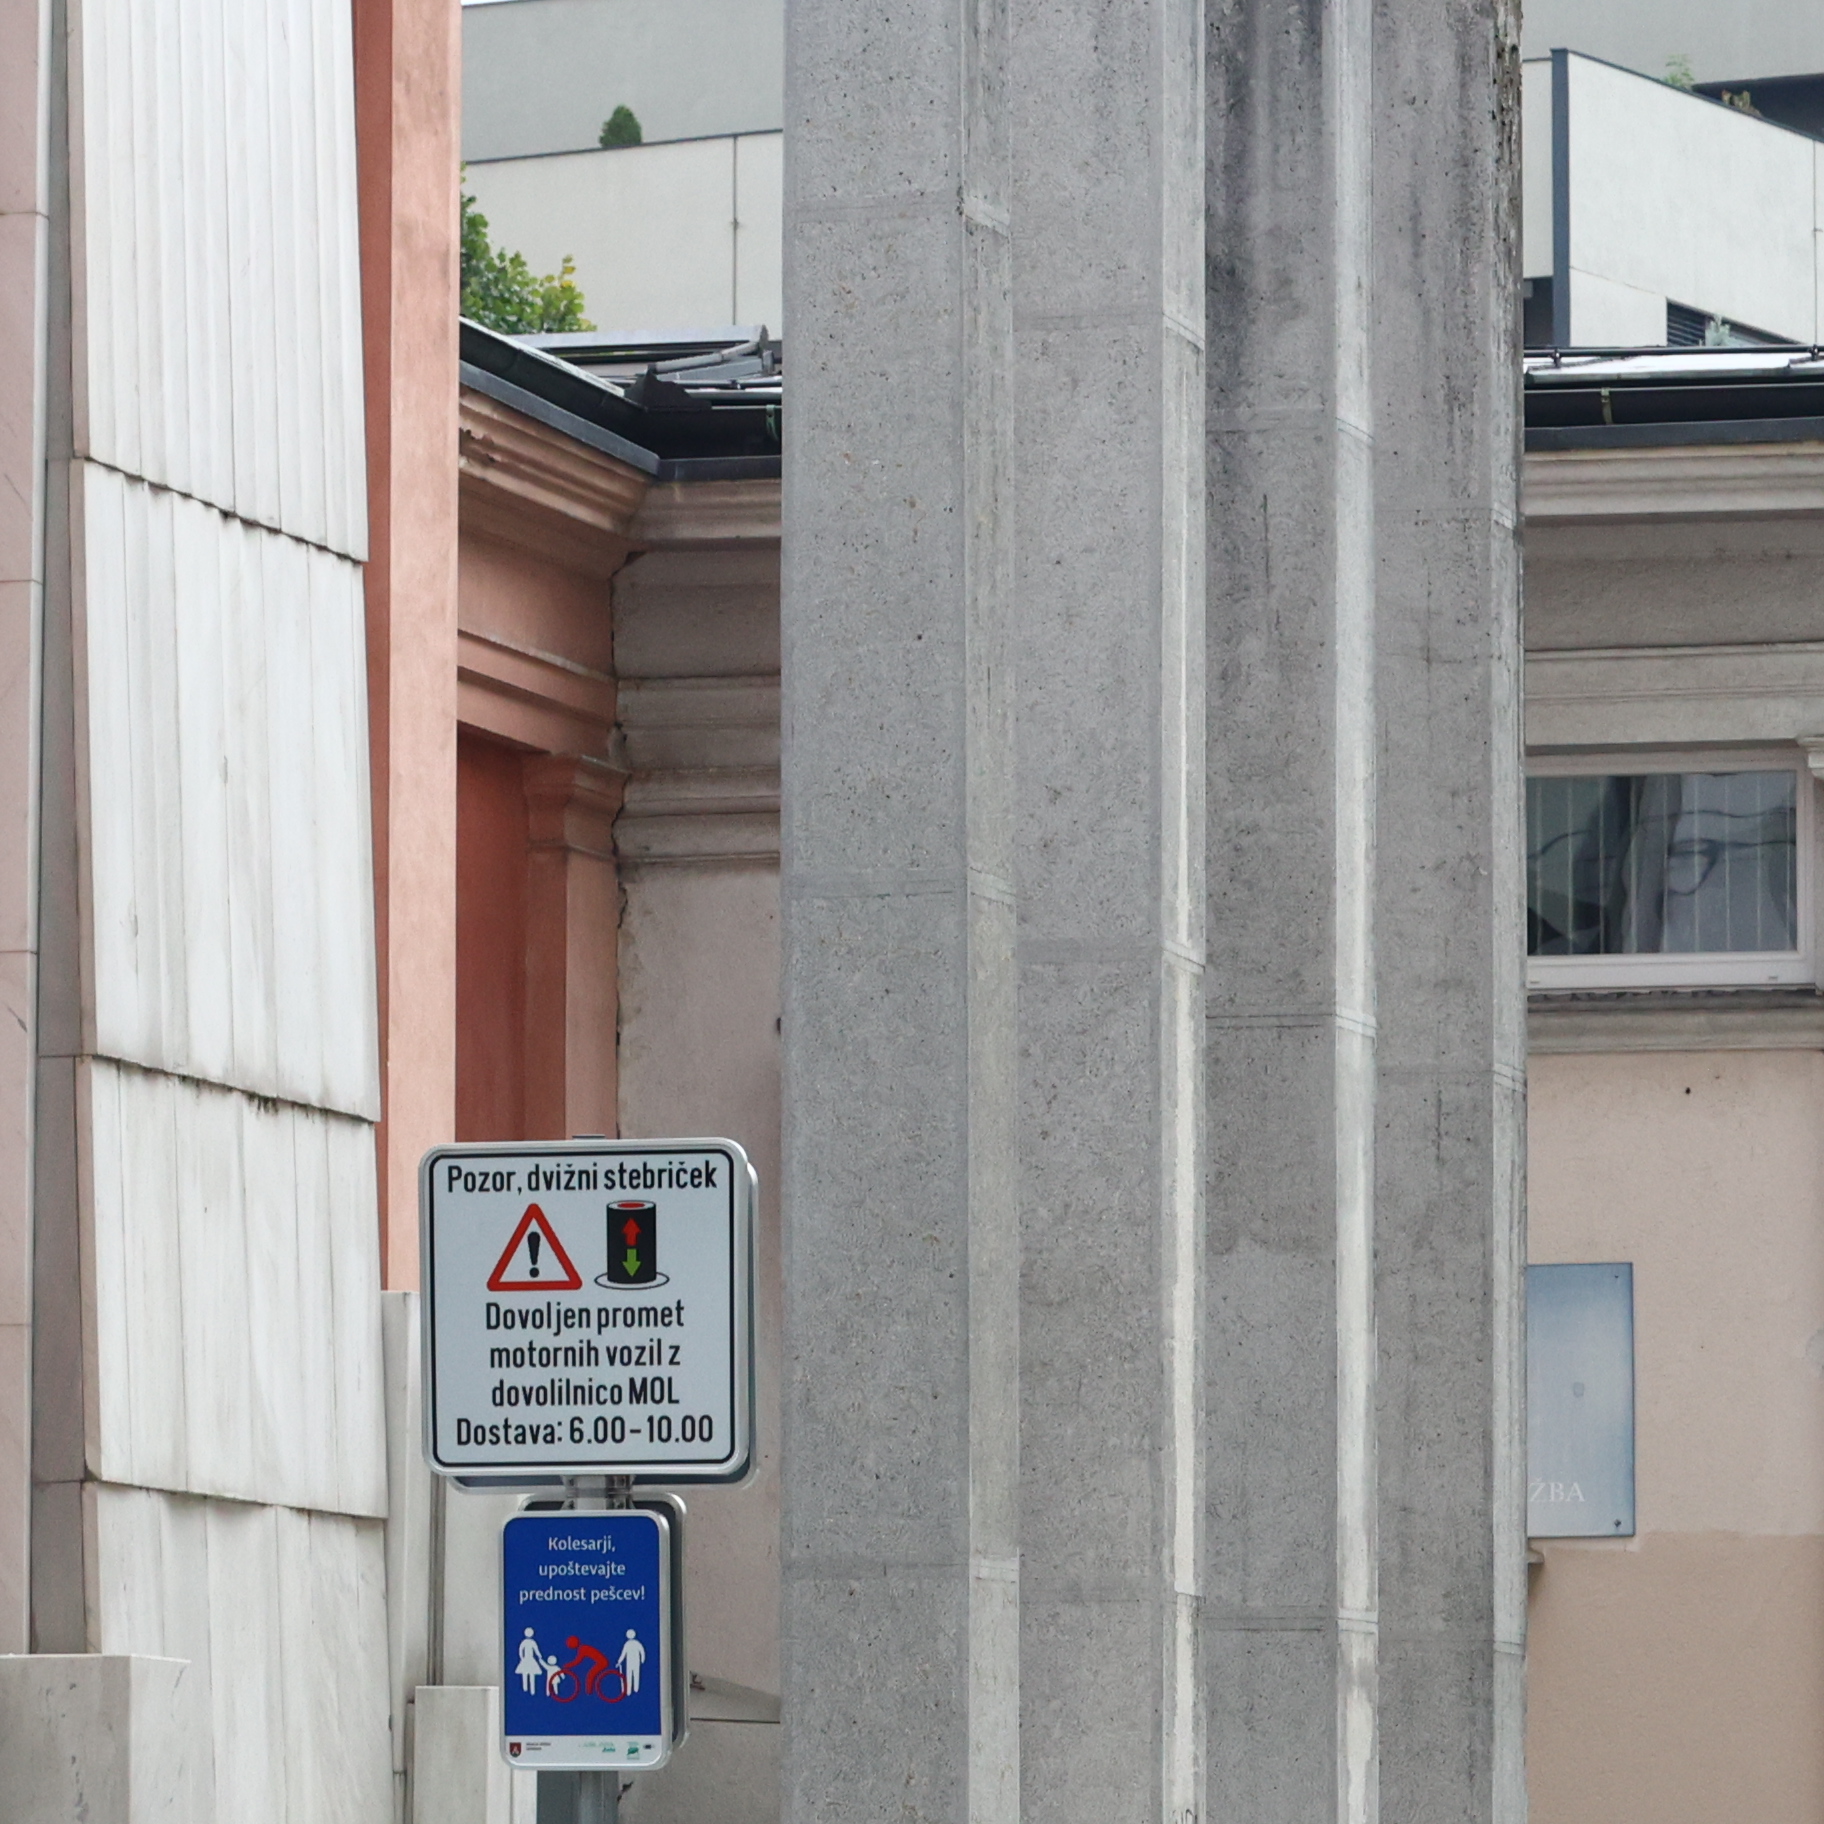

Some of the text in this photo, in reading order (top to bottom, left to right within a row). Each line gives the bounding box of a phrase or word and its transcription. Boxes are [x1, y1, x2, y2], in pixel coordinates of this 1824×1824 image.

[447, 1159, 718, 1196] Pozor, dvižni stebriček
[485, 1299, 685, 1337] Dovoljen promet
[489, 1337, 681, 1369] motornih vozil z
[490, 1375, 681, 1407] dovolilnico MOL
[456, 1416, 564, 1446] Dostava:
[547, 1534, 616, 1555] Kolesarji,
[538, 1560, 626, 1580] upoštevajte
[519, 1584, 646, 1605] prednost pešcev!
